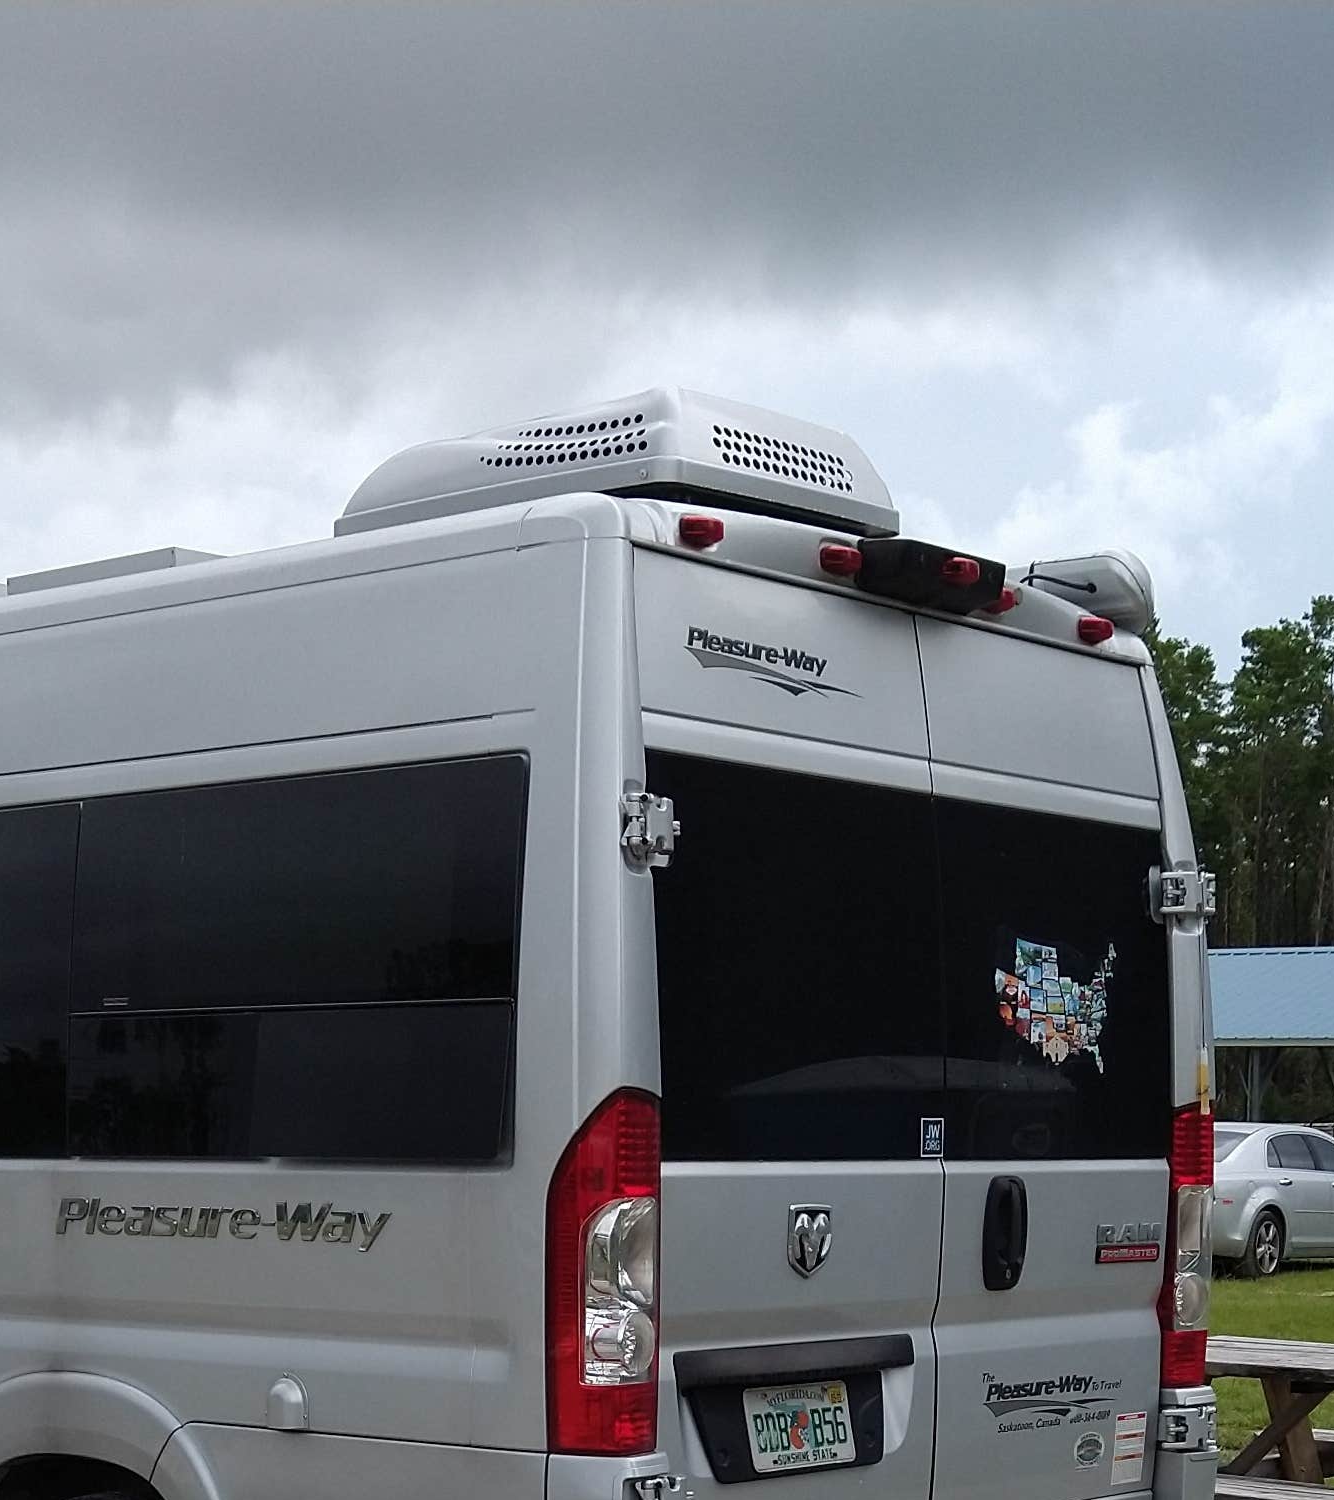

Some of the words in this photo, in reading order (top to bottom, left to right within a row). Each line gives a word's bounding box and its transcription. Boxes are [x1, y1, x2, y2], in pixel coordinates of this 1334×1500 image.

[686, 625, 828, 677] Pleasure-Way
[925, 1124, 941, 1139] JW
[55, 1197, 393, 1253] Pleasure-Way
[982, 1372, 996, 1384] The
[986, 1375, 1093, 1402] Pleasure-Way
[1100, 1379, 1122, 1390] Travel
[809, 1406, 847, 1448] B56
[812, 1449, 834, 1461] STATE
